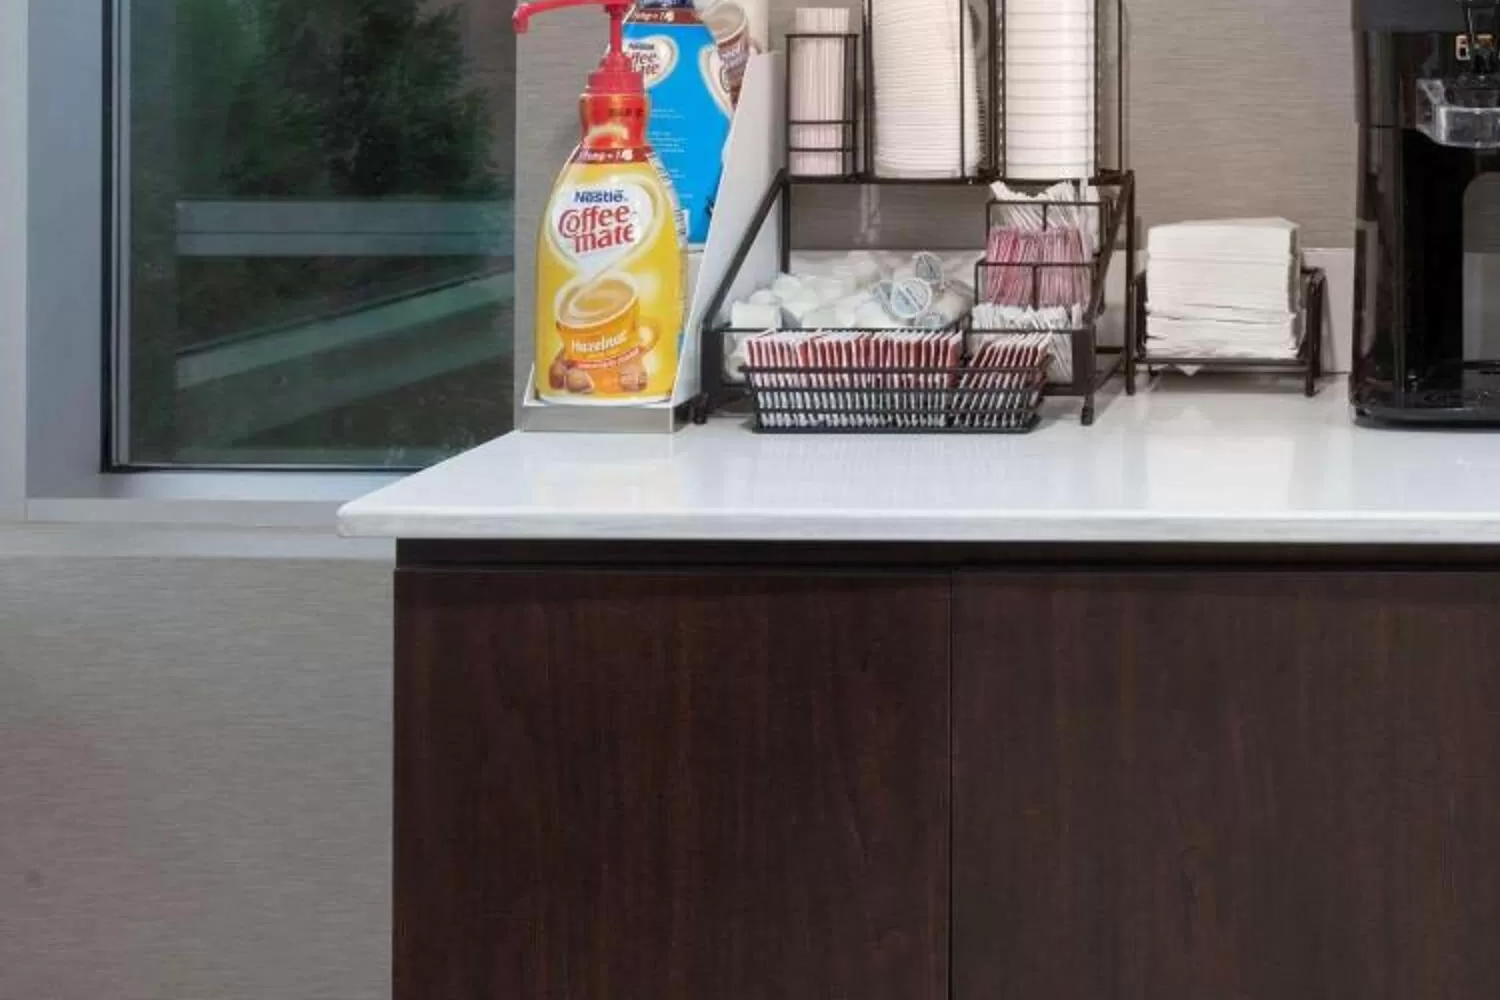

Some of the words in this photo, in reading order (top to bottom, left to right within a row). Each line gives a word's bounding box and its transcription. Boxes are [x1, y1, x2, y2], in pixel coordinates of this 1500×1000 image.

[574, 189, 624, 203] Nestlé
[558, 205, 631, 238] Coffee
[574, 223, 636, 253] mate
